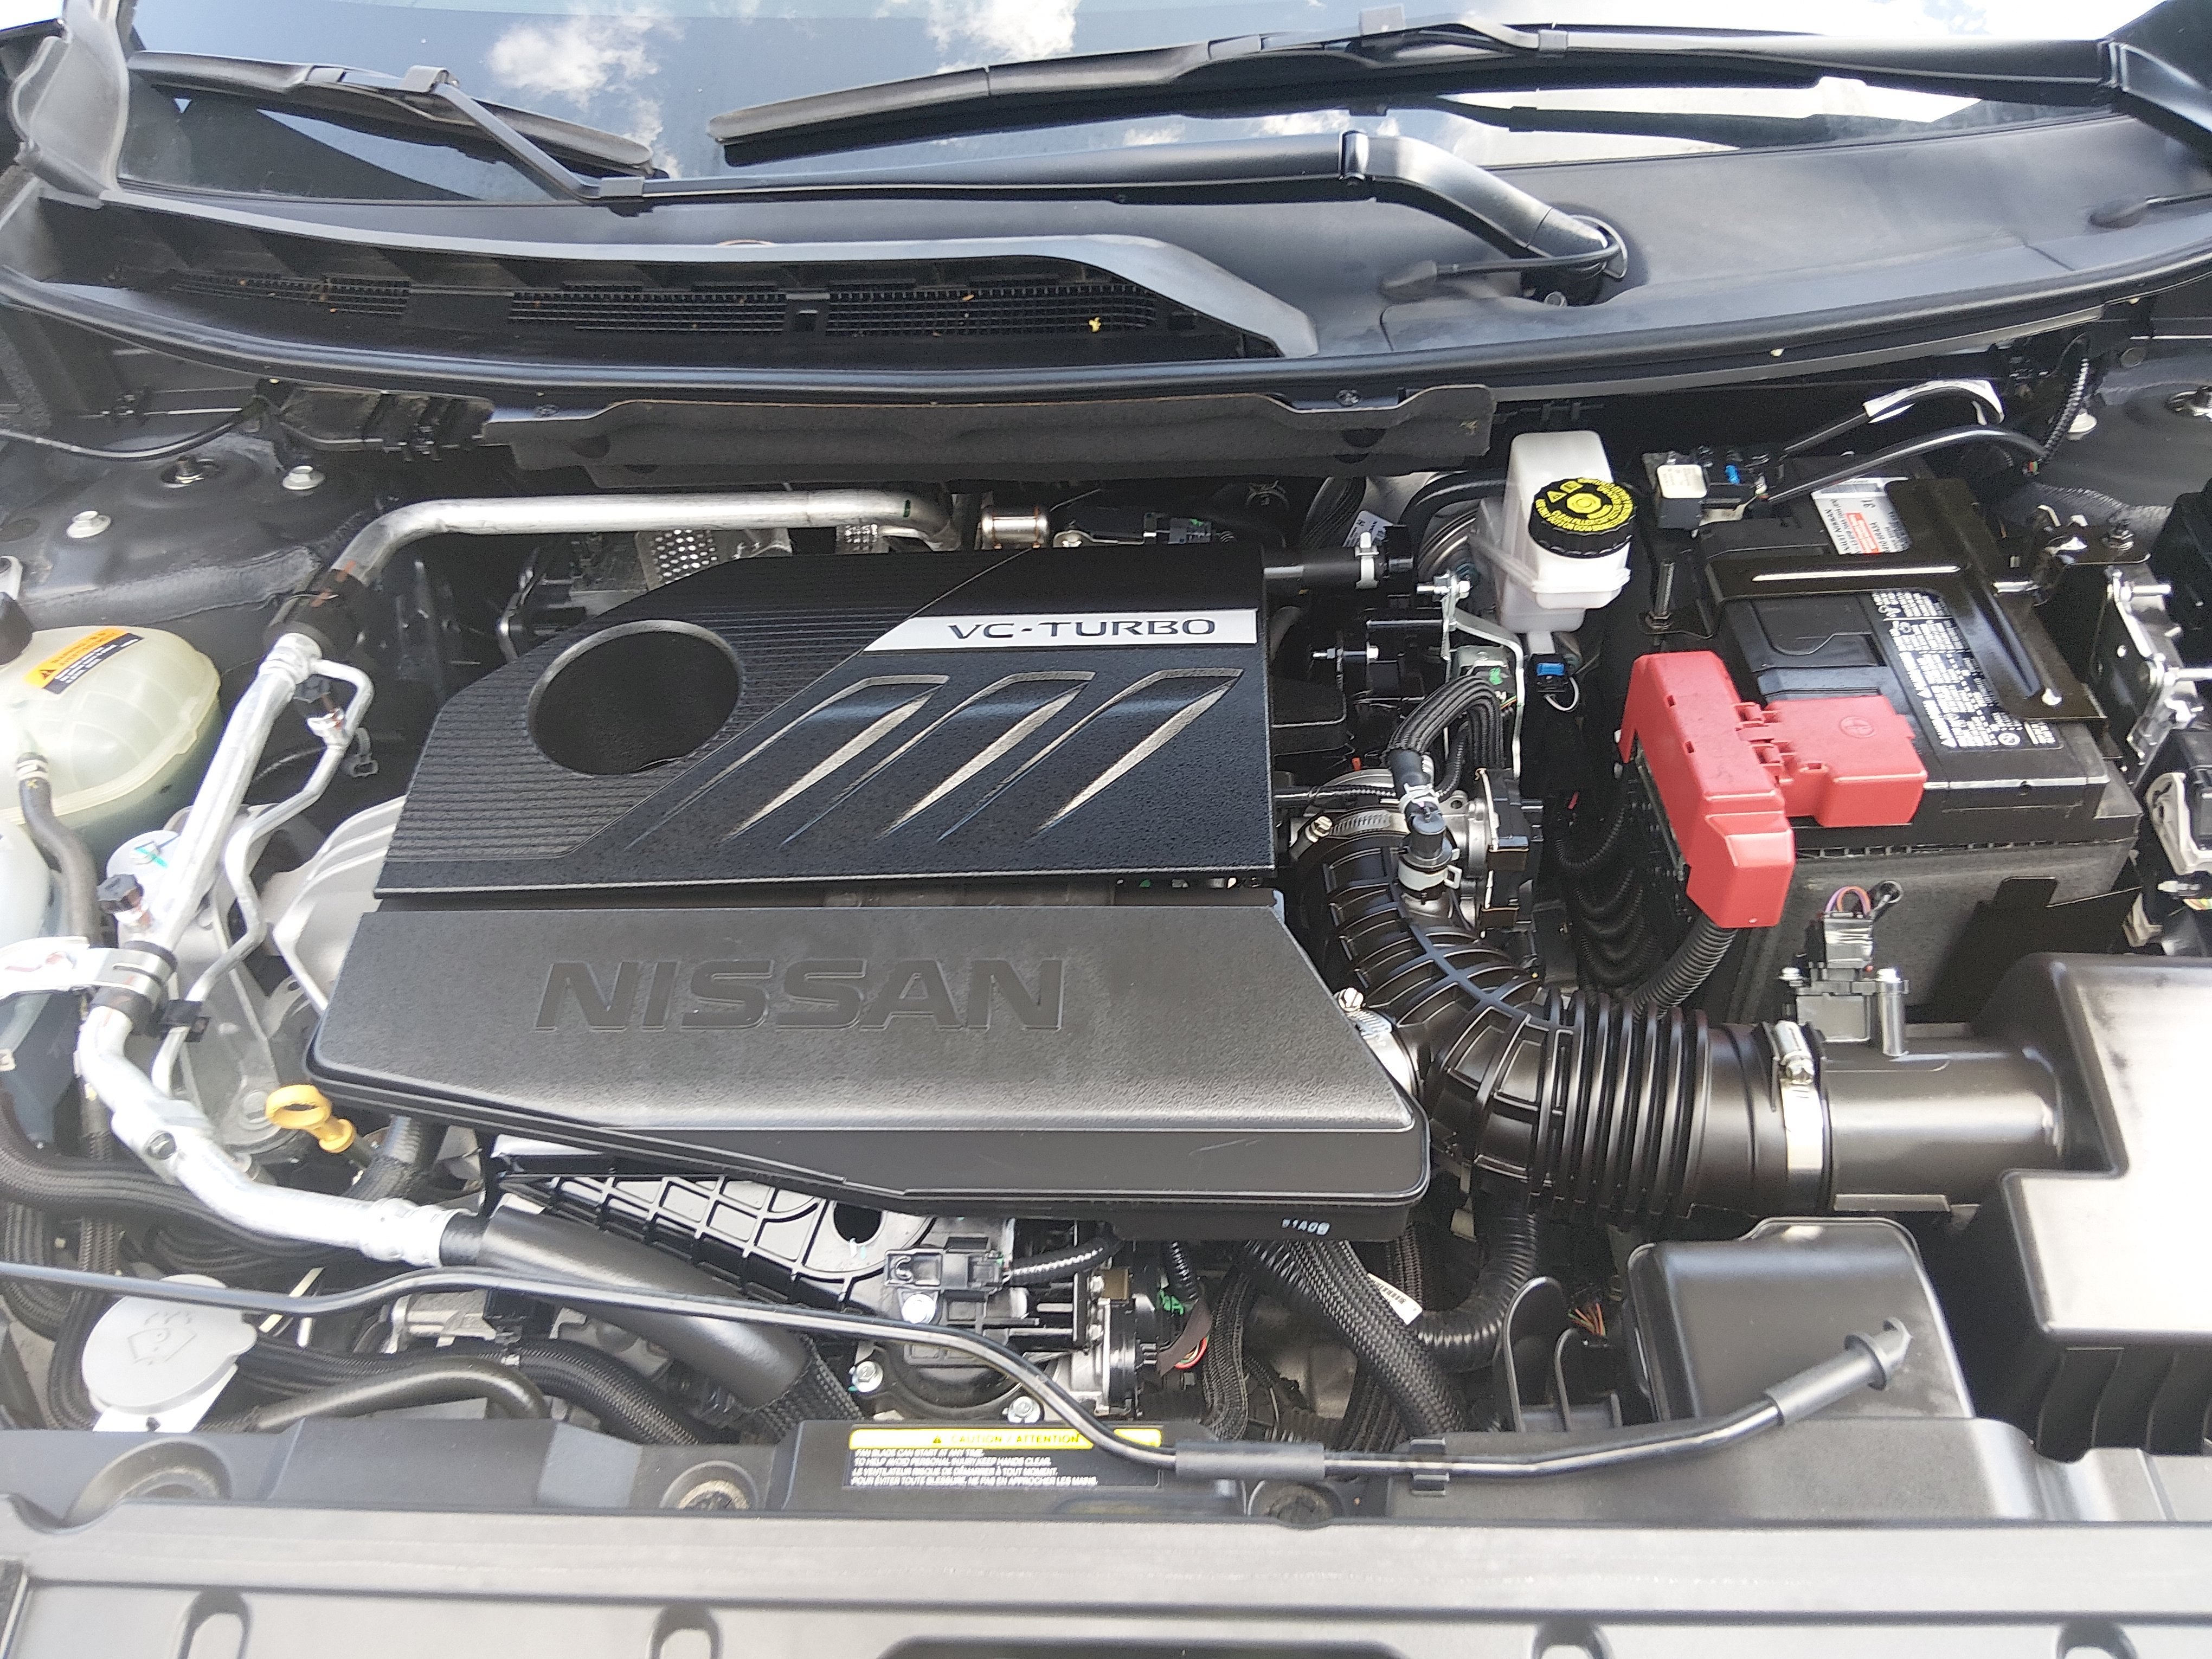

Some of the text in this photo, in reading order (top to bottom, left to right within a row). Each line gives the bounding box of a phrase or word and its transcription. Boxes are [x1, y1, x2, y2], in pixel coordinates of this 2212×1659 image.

[948, 619, 1216, 640] VC-TURBO
[535, 959, 1064, 1032] NISSAN
[950, 1435, 1002, 1443] CAUTION
[1016, 1434, 1079, 1443] ATTENTION
[855, 1457, 866, 1466] TO
